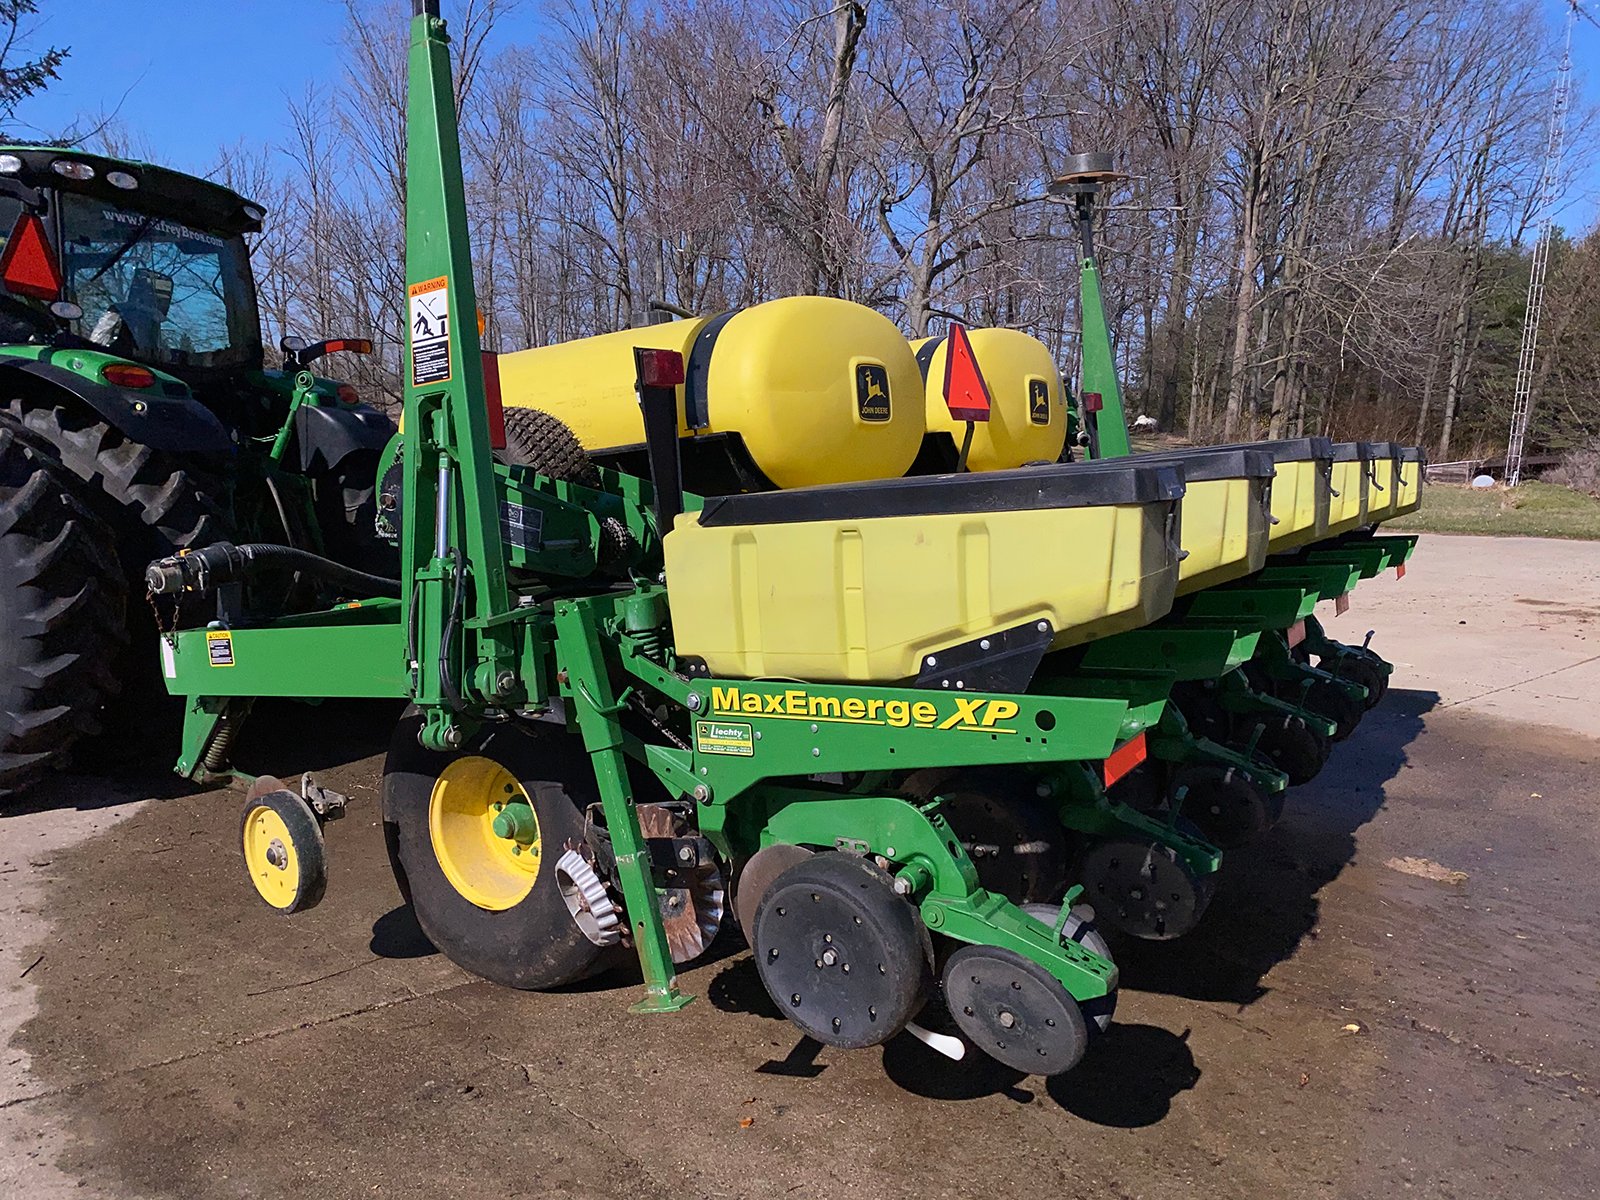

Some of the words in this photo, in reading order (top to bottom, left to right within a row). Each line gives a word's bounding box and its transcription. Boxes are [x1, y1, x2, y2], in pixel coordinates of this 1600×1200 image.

[417, 279, 446, 293] WARNING
[711, 686, 938, 728] MaxEmerge
[937, 698, 1020, 730] XP
